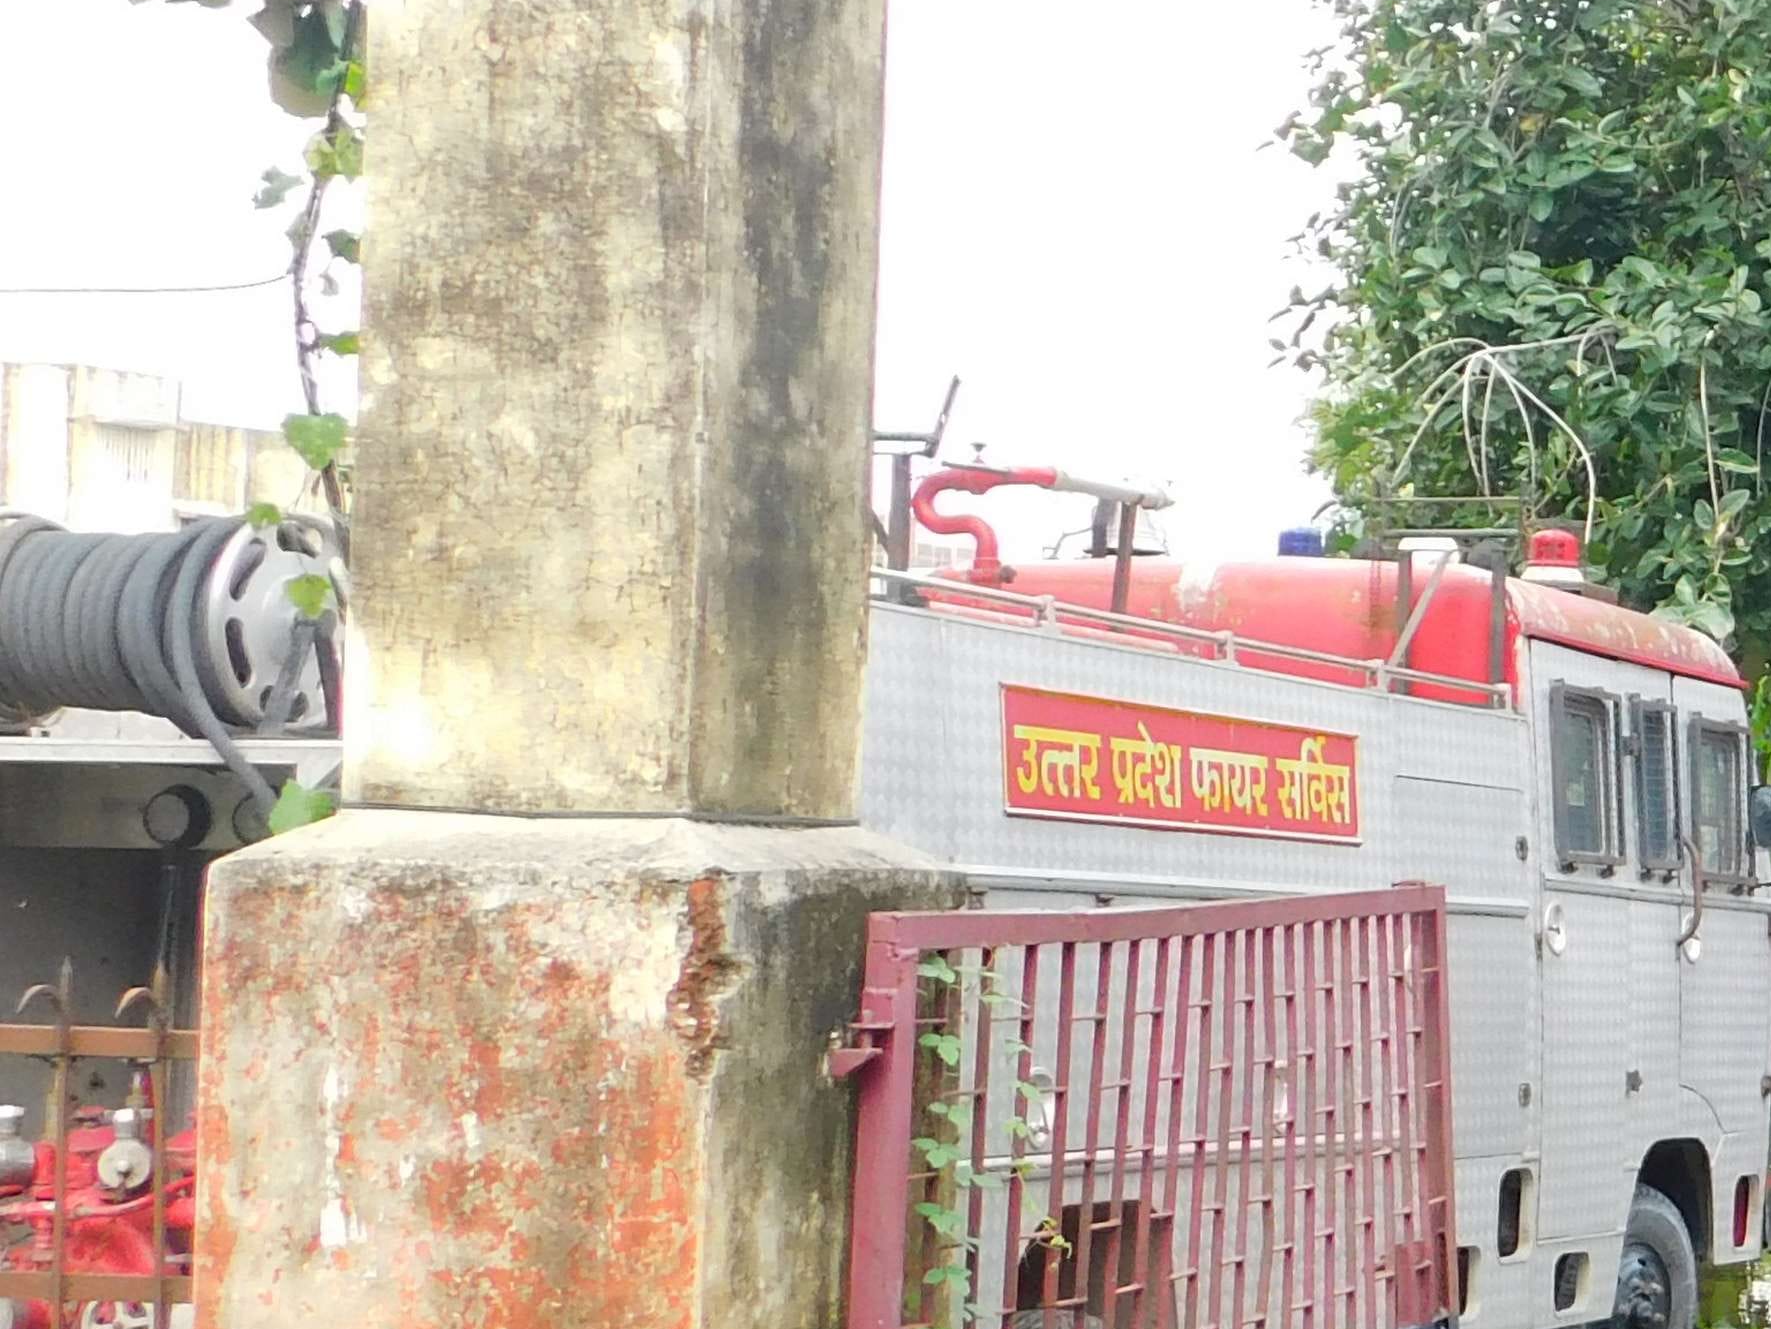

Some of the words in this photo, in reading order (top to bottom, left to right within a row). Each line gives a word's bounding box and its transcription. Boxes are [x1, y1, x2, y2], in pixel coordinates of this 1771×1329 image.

[1014, 724, 1101, 800] उत्तर
[1110, 720, 1181, 808] प्रदेश
[1189, 746, 1268, 816] फायर
[1276, 735, 1350, 824] सर्विस
